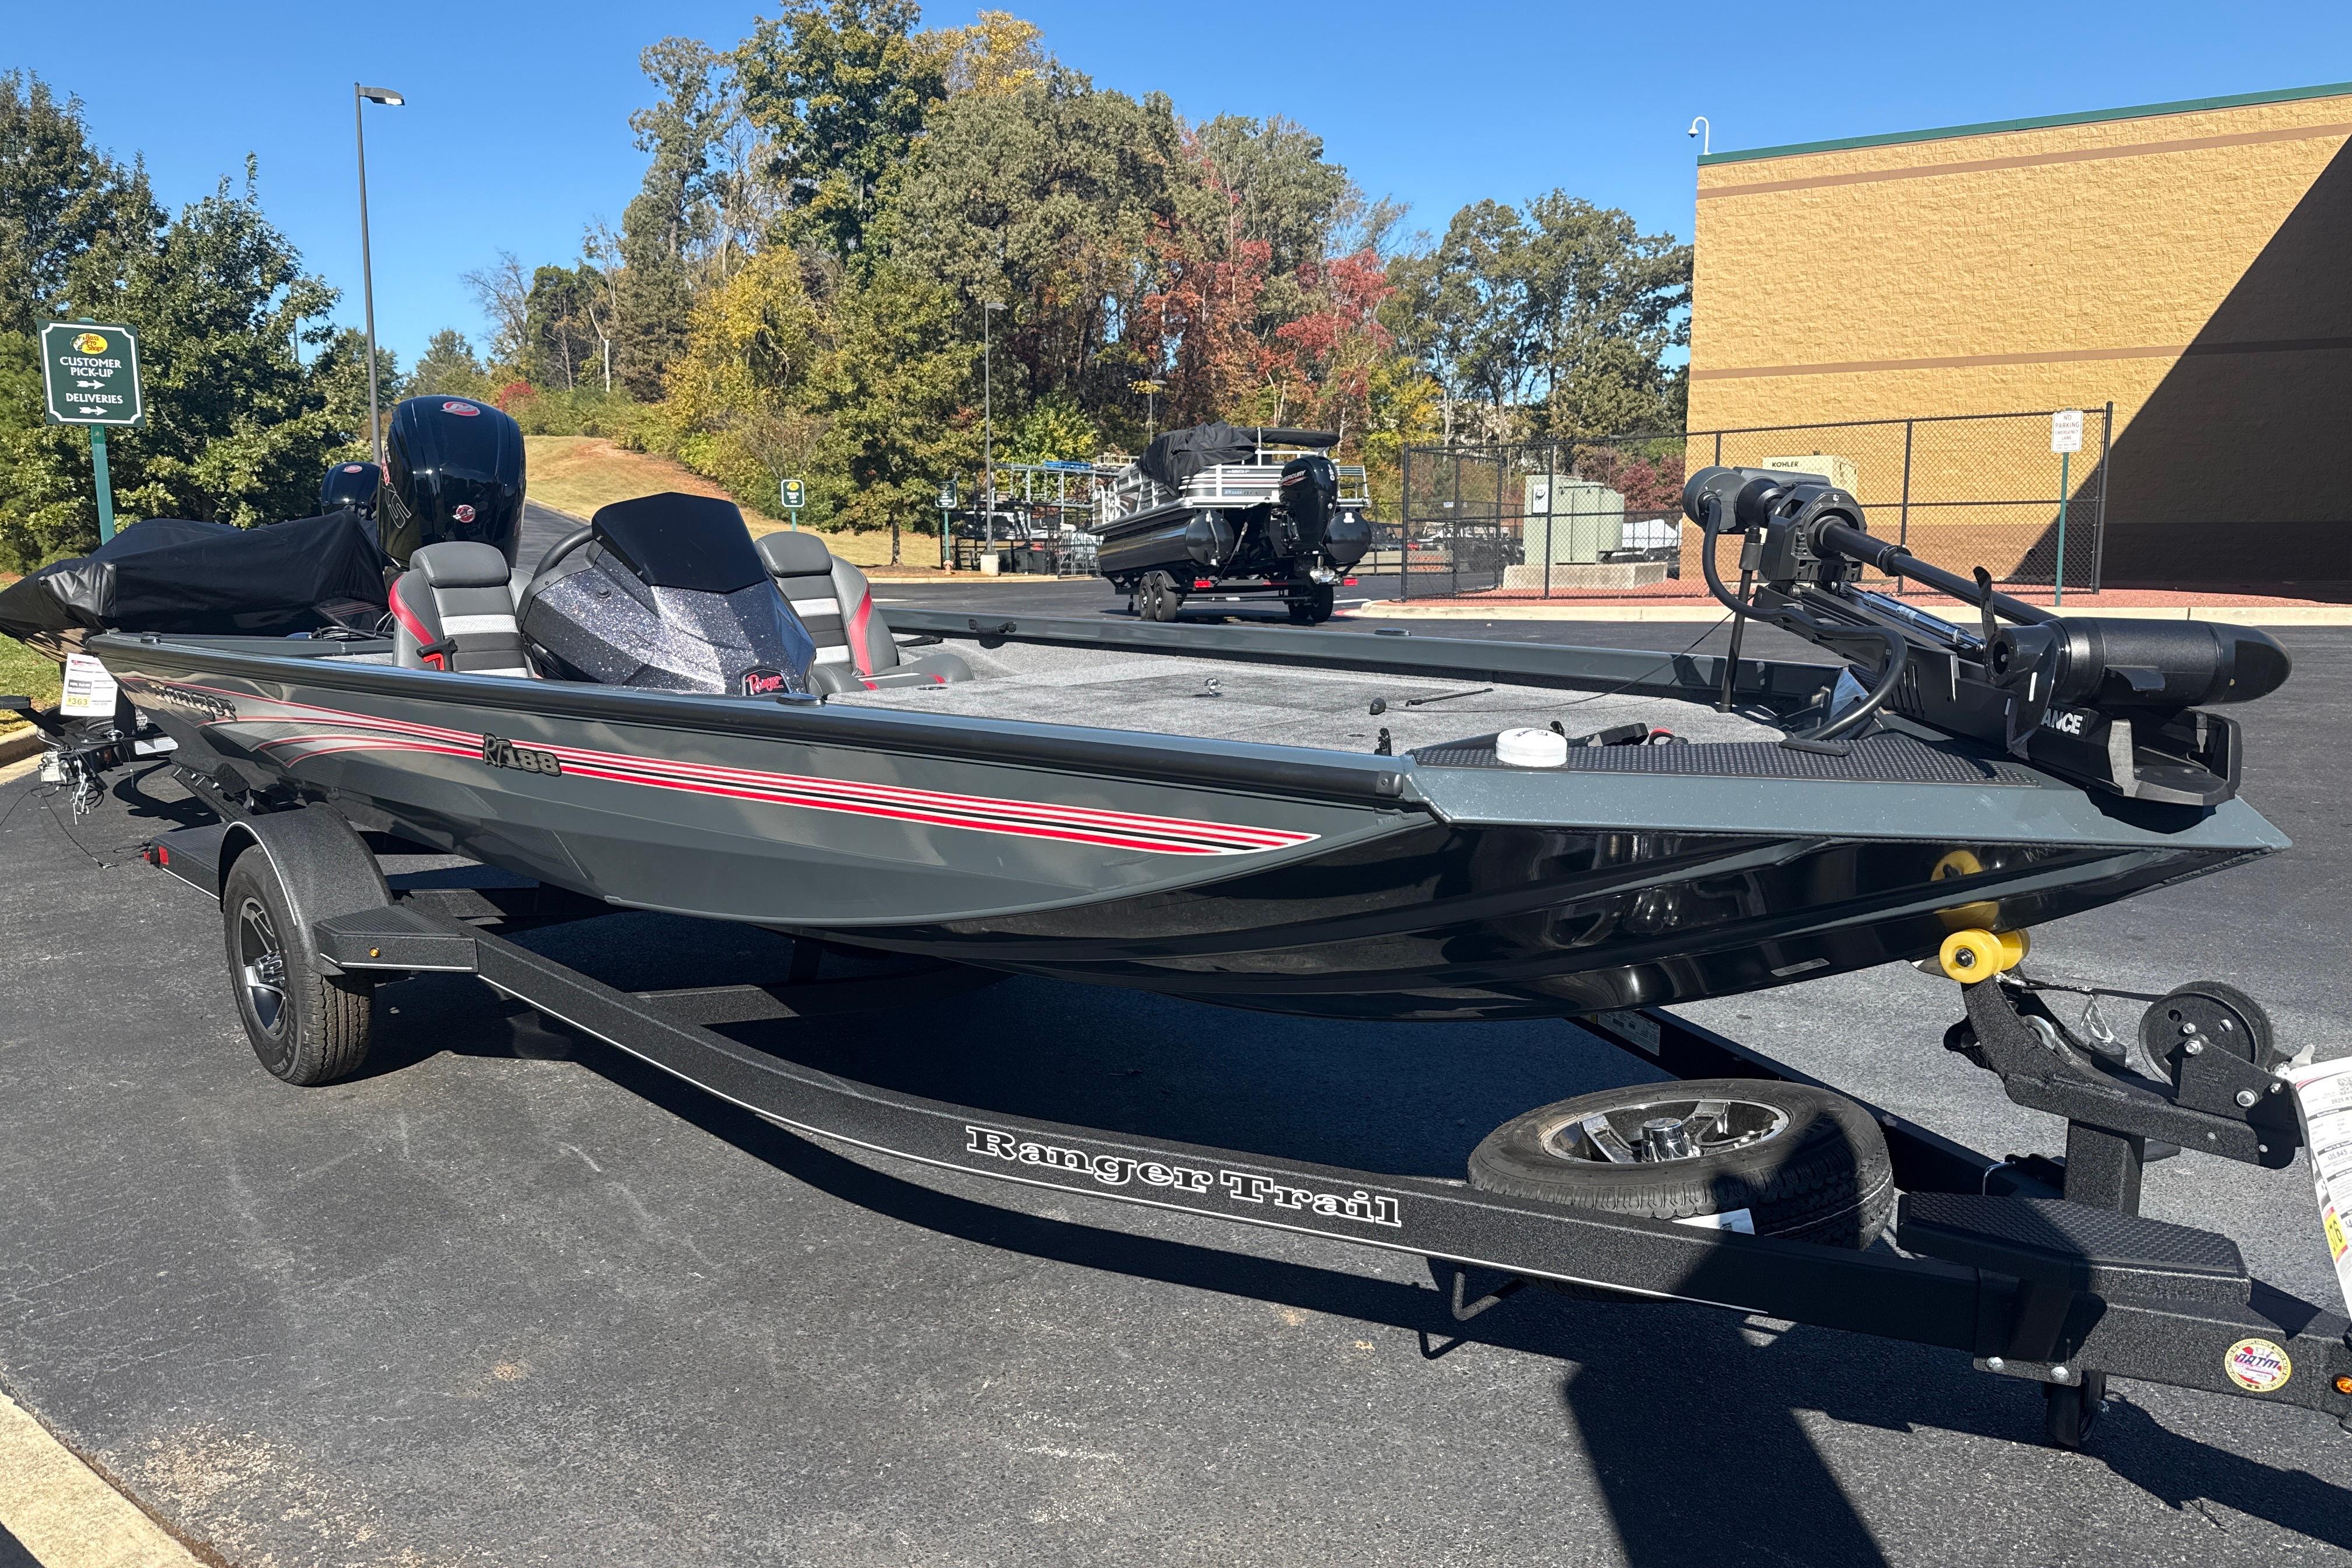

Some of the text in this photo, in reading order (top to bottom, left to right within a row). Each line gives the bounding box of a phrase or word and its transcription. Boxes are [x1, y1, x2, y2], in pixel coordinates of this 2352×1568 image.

[60, 356, 122, 368] CUSTOMER
[71, 367, 113, 377] PICK-UP
[65, 393, 123, 404] DELIVERIES
[746, 674, 783, 695] Ranger
[146, 679, 238, 722] Ranger
[2041, 708, 2083, 735] ANCE
[483, 733, 561, 776] RT188
[965, 1125, 1401, 1228] Ranger Trail
